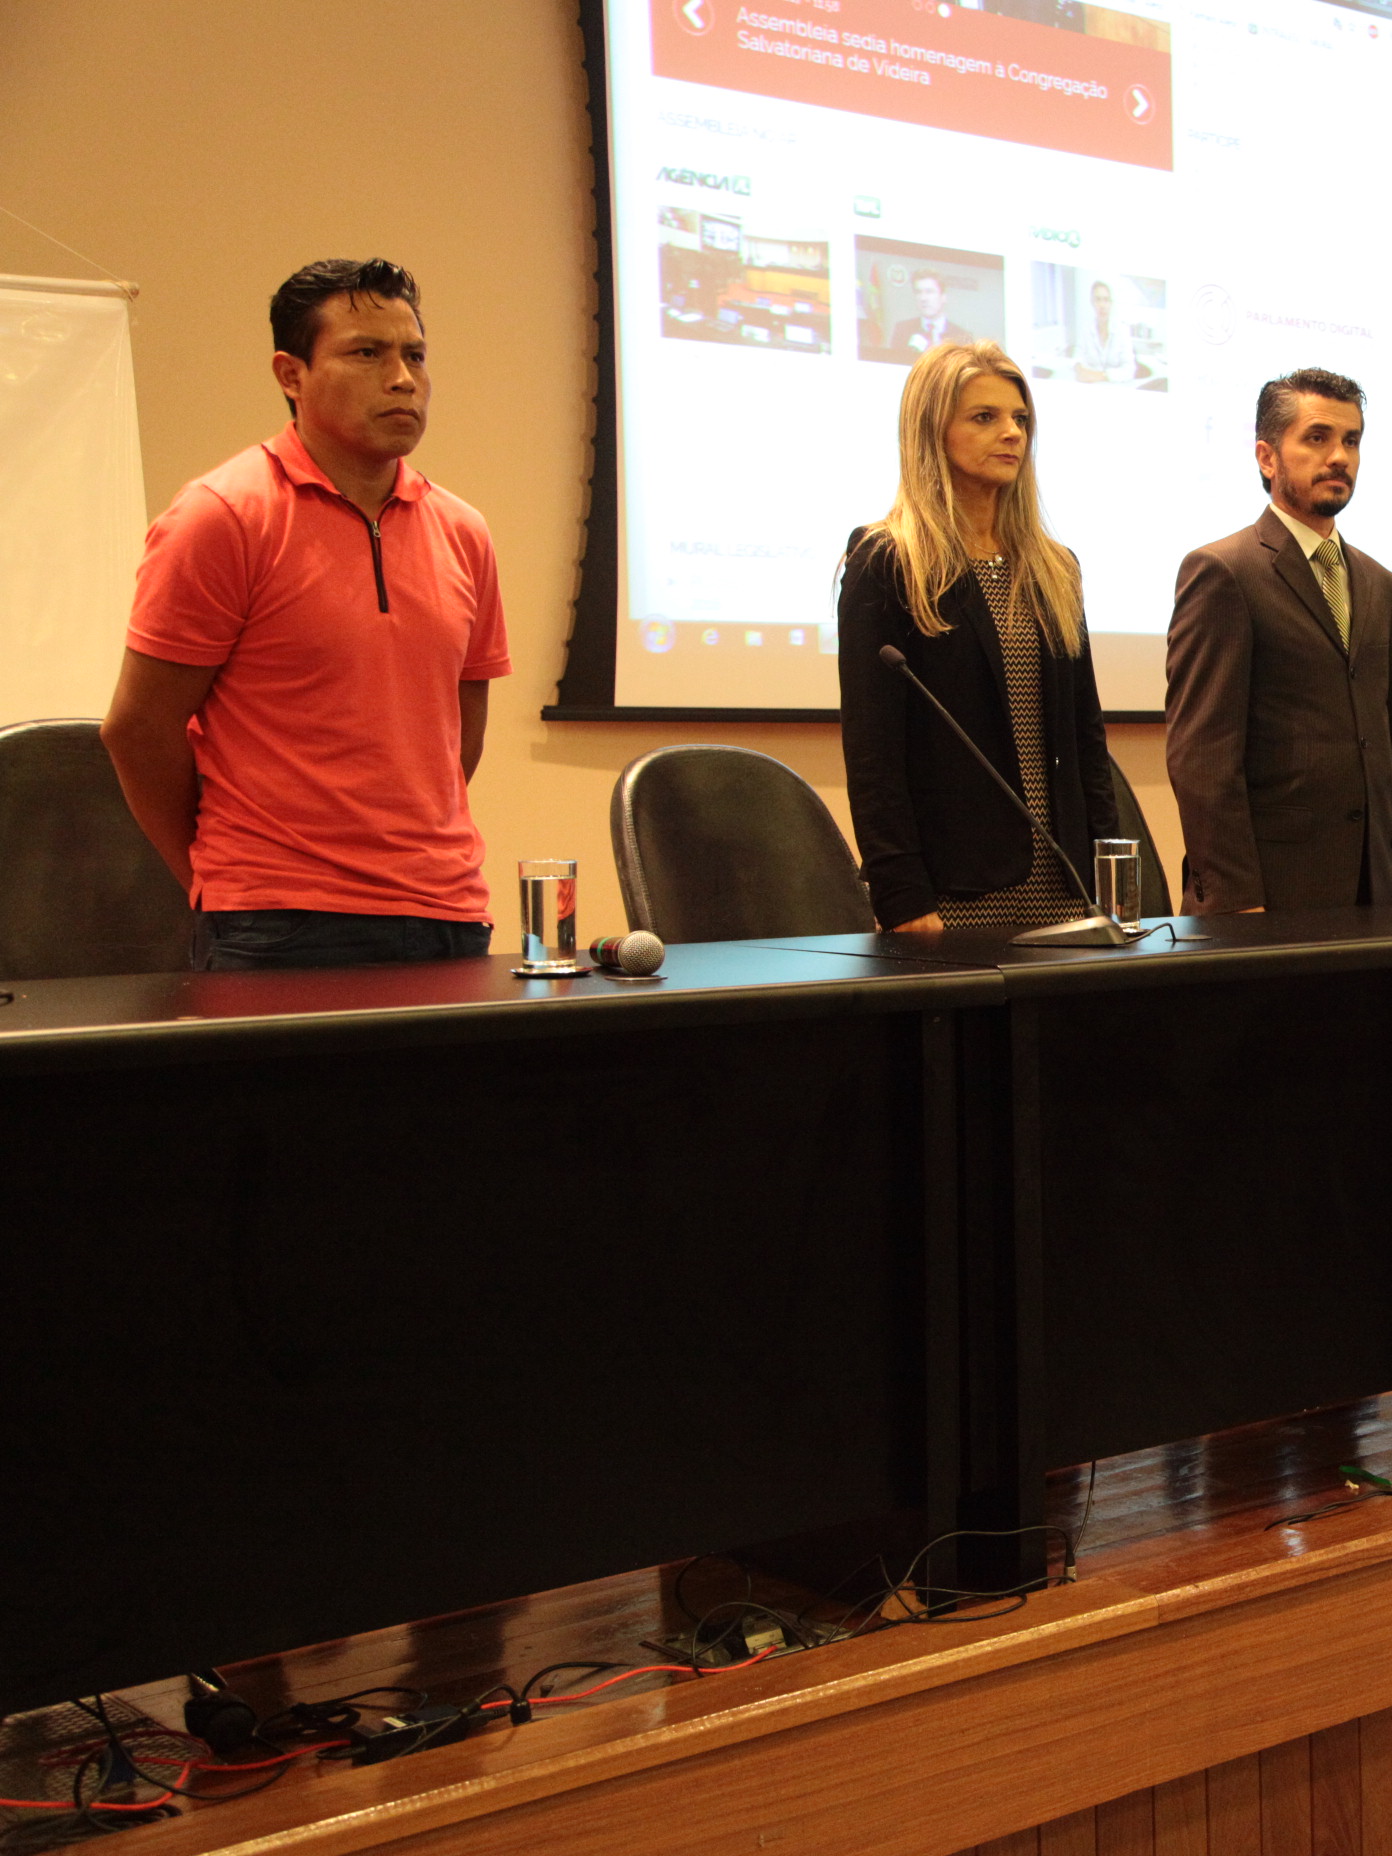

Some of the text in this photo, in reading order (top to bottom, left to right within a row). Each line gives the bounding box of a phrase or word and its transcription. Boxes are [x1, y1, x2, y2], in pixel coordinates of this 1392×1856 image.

[736, 6, 839, 44] Assembleia
[842, 31, 887, 54] sedia
[890, 38, 992, 74] homenagem
[1007, 63, 1108, 99] Congregação
[736, 30, 931, 85] Salvatoriana de Videira
